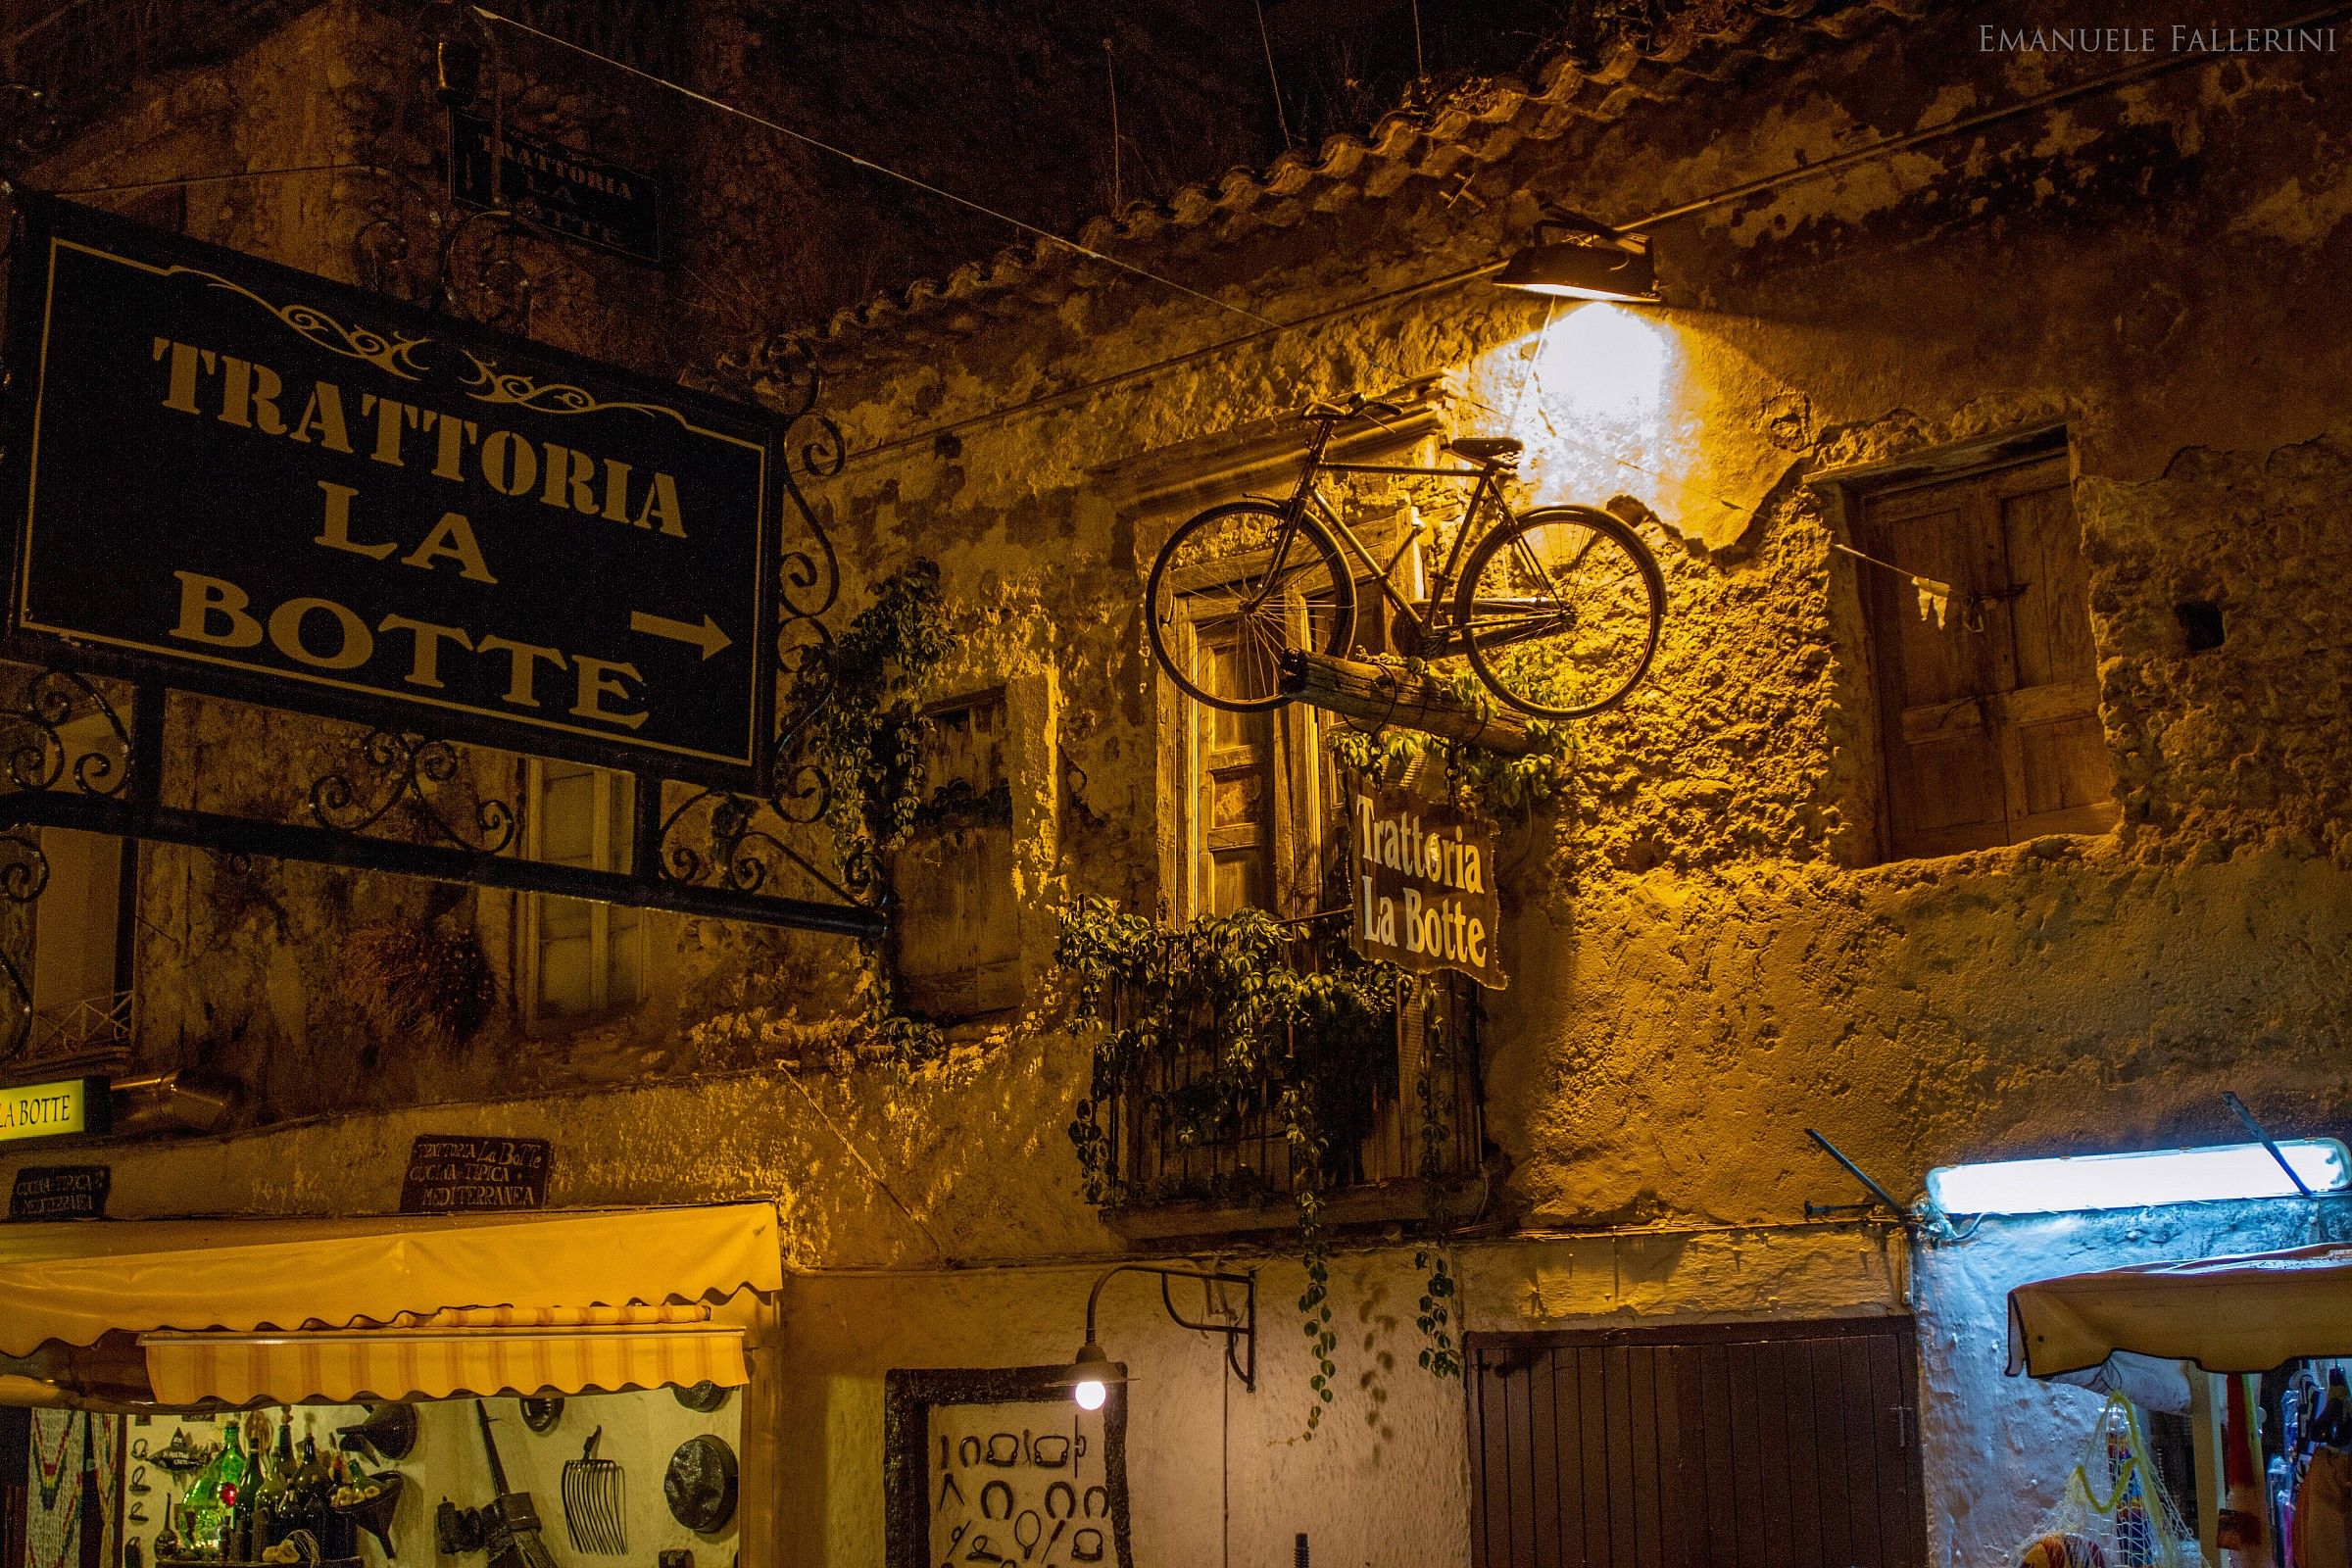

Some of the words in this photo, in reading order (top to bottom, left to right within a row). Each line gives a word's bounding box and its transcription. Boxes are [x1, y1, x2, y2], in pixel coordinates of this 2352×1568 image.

[152, 336, 688, 540] TRATTORIA
[313, 480, 500, 585] LA
[168, 569, 651, 732] BOTTE
[1356, 794, 1486, 895] Trattoria
[1361, 875, 1398, 948] La
[1402, 887, 1488, 968] Botte
[19, 1094, 71, 1126] BOTTE
